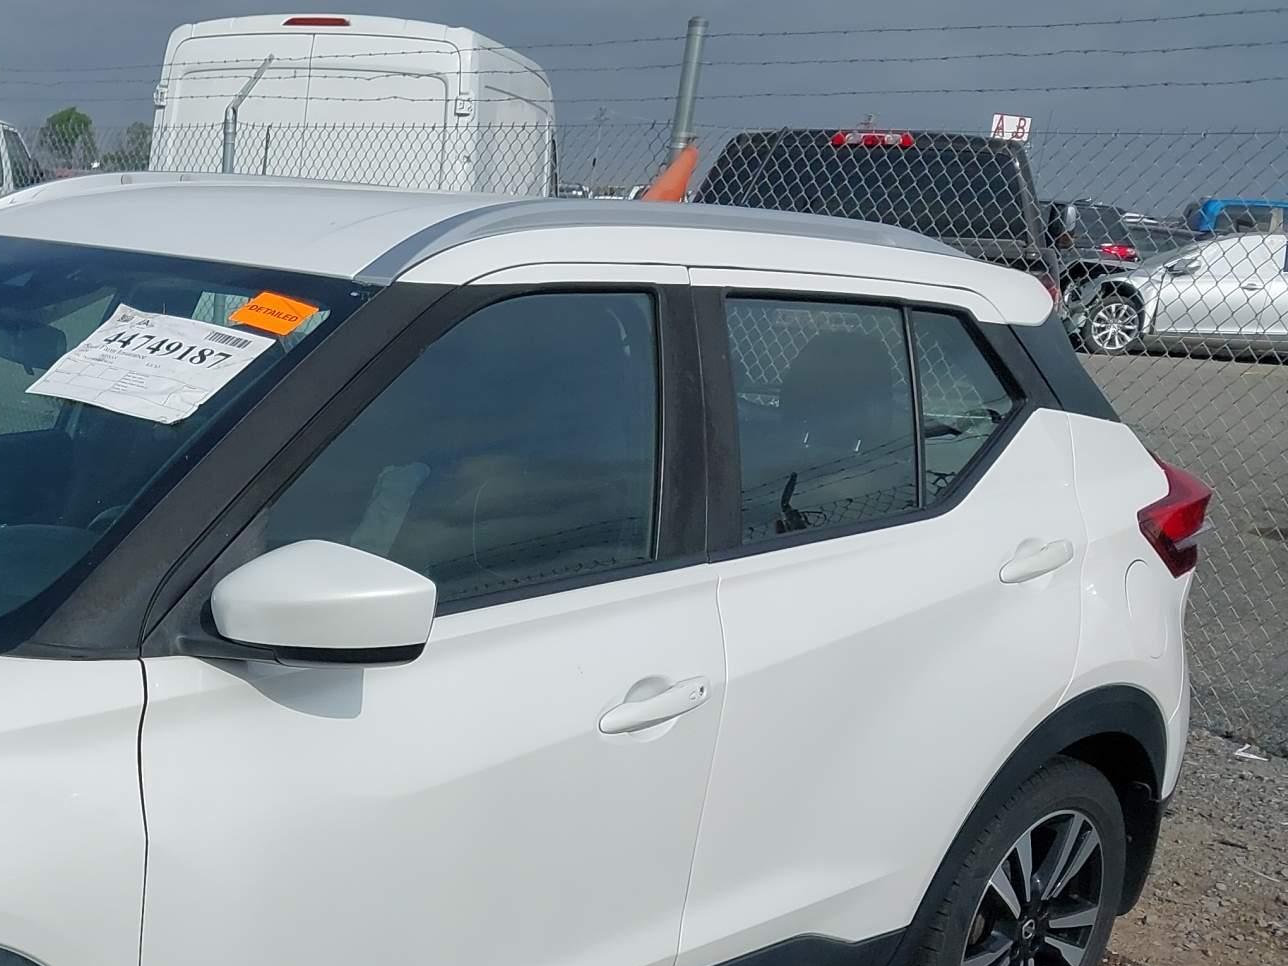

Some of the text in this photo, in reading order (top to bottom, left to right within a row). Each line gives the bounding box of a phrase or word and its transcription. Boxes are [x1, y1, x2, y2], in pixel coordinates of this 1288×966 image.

[993, 115, 1027, 139] A B
[248, 304, 299, 322] DETAILED
[103, 331, 233, 369] 44749187
